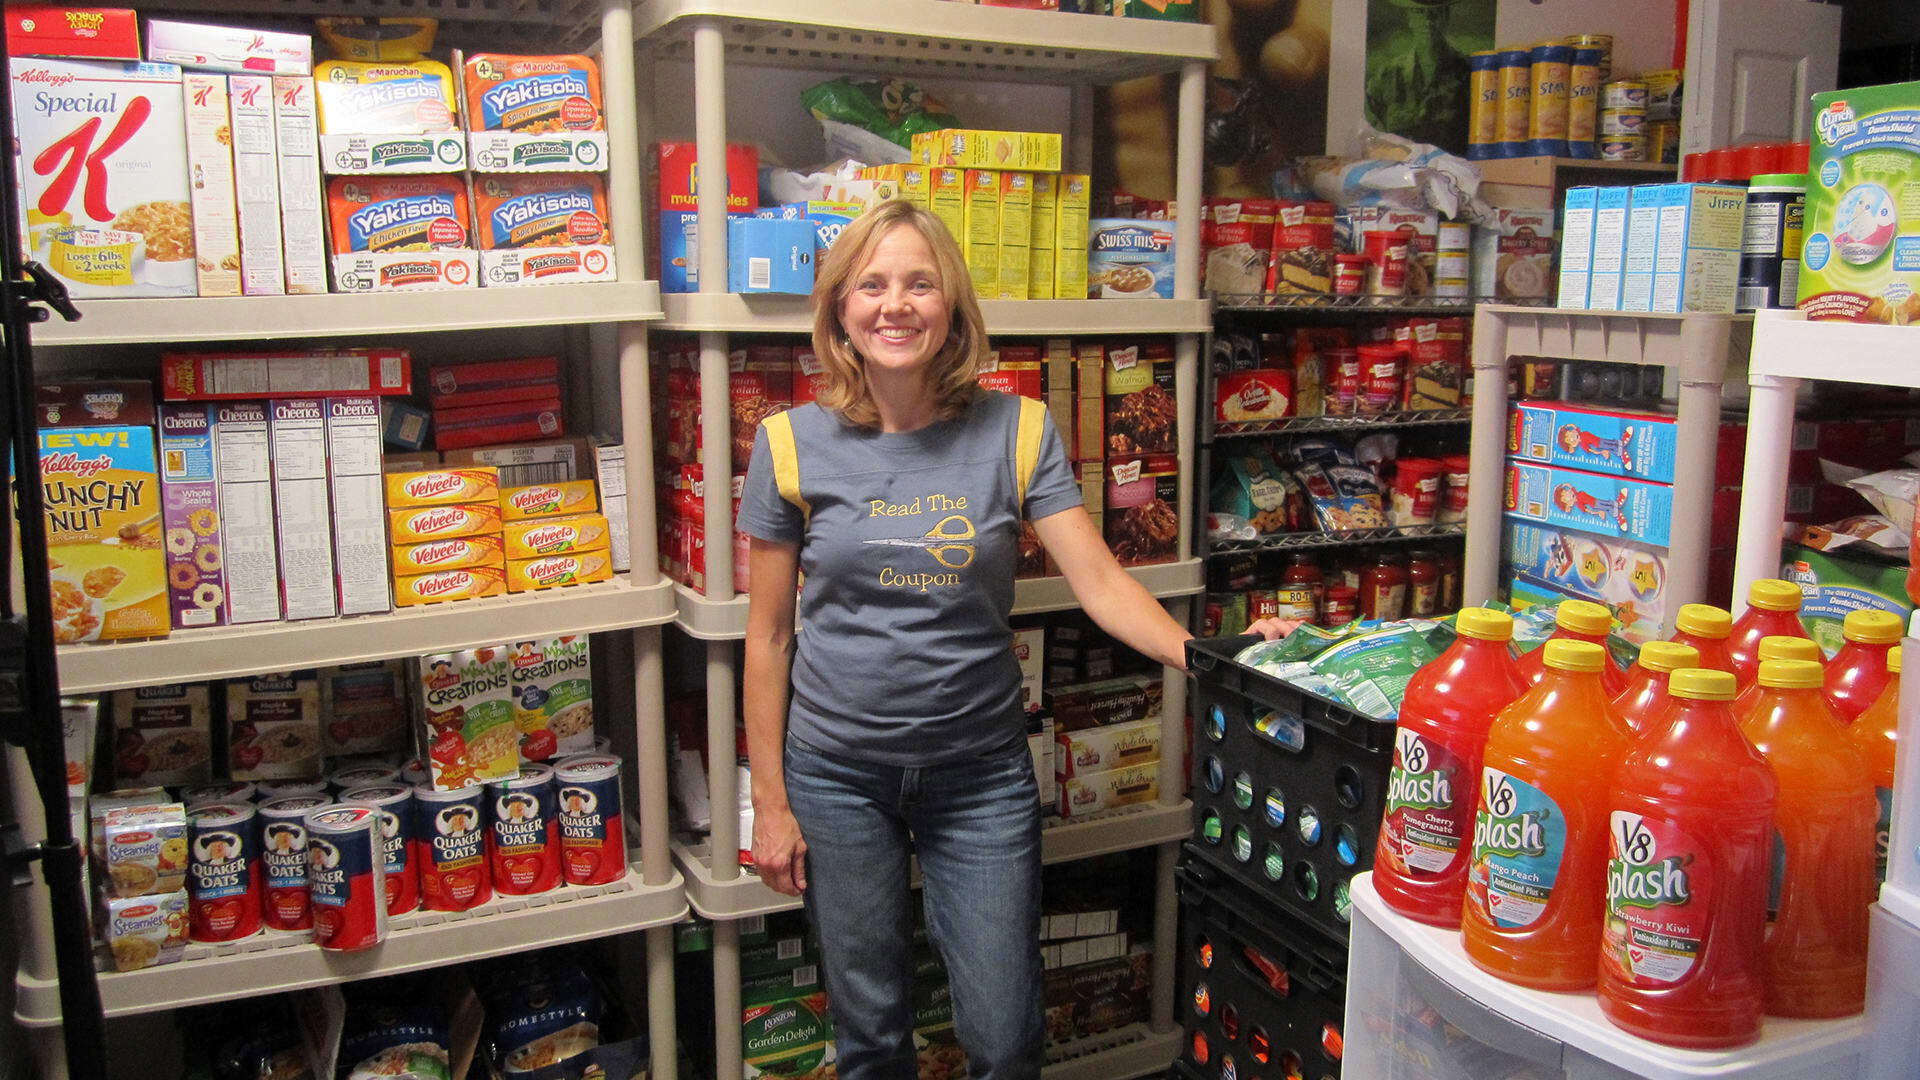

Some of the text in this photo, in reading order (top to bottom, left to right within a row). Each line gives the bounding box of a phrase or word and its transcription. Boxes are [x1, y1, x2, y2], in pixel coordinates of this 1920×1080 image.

[19, 67, 76, 87] Kellogg's
[33, 91, 118, 118] Special
[490, 78, 585, 111] Yakisoba
[1868, 123, 1916, 135] DentaShield
[33, 95, 152, 223] K
[114, 158, 152, 171] original
[499, 193, 590, 227] Yakisoba
[1708, 196, 1742, 210] JIFFY
[356, 199, 452, 236] Yakisoba
[373, 227, 408, 246] Chicken
[66, 252, 90, 261] Lose
[83, 261, 126, 272] 2 weeks
[528, 257, 576, 270] Yakisoba
[1116, 376, 1146, 384] Walnut
[220, 408, 264, 422] Cheerios
[276, 406, 320, 420] Cheerios
[332, 404, 376, 417] Cheerios
[164, 415, 207, 429] Cheerios
[38, 432, 130, 449] EW!
[39, 454, 112, 477] Kellogg's
[43, 478, 145, 513] UNCHY
[182, 489, 212, 498] Whole
[410, 476, 462, 497] Velveeta
[514, 488, 560, 508] Velveeta
[868, 494, 968, 518] Read The
[50, 507, 103, 534] NUT
[414, 510, 464, 533] Velveeta
[527, 527, 572, 548] Velveeta
[415, 541, 466, 564] Velveeta
[530, 559, 575, 580] Velveeta
[418, 572, 470, 595] Velveeta
[880, 568, 960, 592] Coupon
[252, 678, 294, 691] Quaker
[1403, 734, 1426, 773] V8
[1488, 773, 1514, 816] V8
[496, 818, 544, 835] QUAKER
[558, 814, 602, 827] QUAKER
[1402, 812, 1454, 834] Pomegranate
[1425, 814, 1454, 826] Cherry
[434, 829, 482, 850] QUAKER
[503, 832, 536, 846] OATS
[564, 826, 594, 838] OATS
[1406, 829, 1448, 846] Antioxidant Plus
[1622, 819, 1652, 863] V8
[443, 846, 477, 860] OATS
[192, 858, 246, 878] QUAKER
[269, 866, 304, 878] OATS
[1484, 858, 1540, 883] Mango Peach
[201, 874, 239, 890] OATS
[1494, 878, 1538, 896] Antioxidant Plus
[1614, 907, 1690, 934] Strawberry Kiwi
[1634, 931, 1686, 950] Antioxidant Plus
[746, 1009, 762, 1018] New
[764, 1009, 797, 1032] RONZONI
[748, 1026, 817, 1050] Garden Delight
